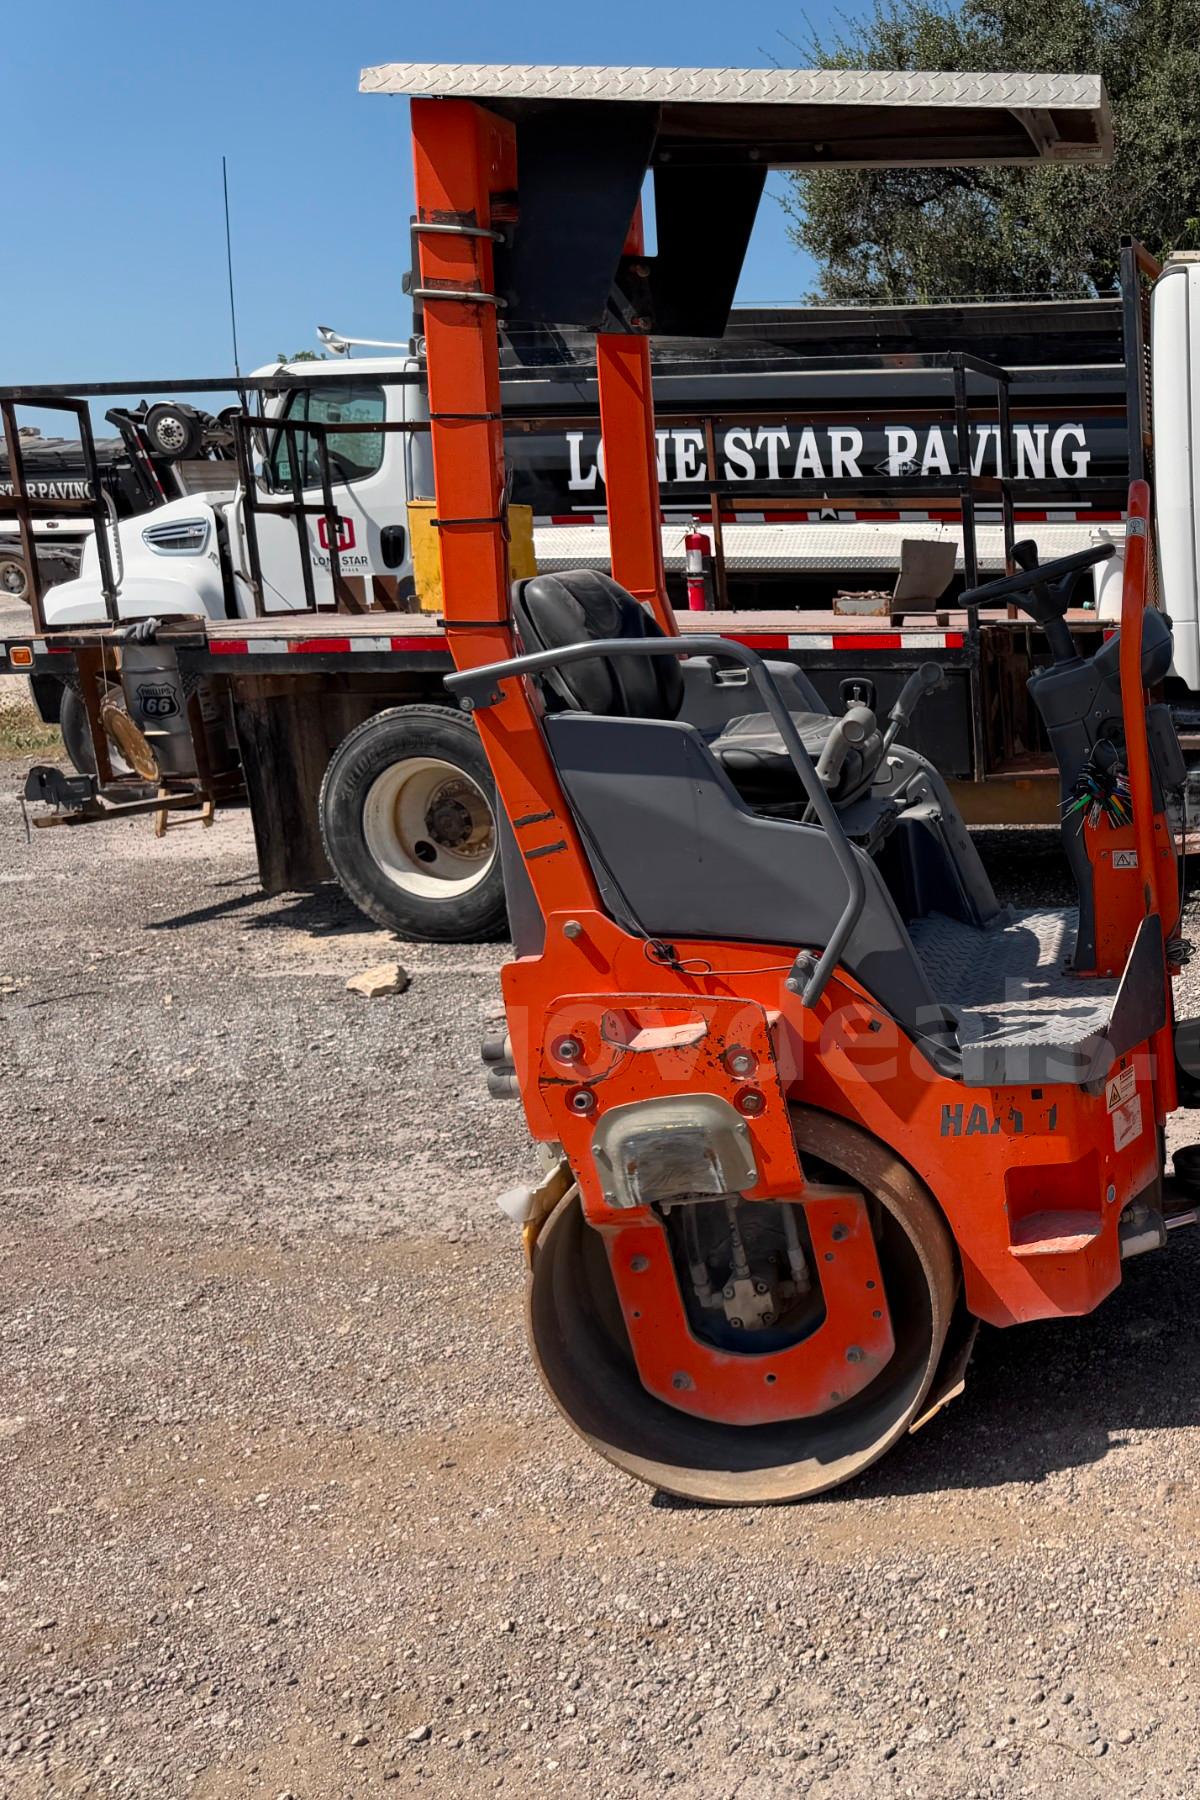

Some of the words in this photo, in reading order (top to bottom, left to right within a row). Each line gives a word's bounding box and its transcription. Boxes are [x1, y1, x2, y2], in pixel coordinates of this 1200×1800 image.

[566, 427, 707, 490] LNE
[723, 425, 863, 480] STAR
[884, 423, 1091, 479] PAVING
[0, 483, 37, 498] STR
[341, 556, 368, 566] STAR
[146, 698, 170, 713] 66
